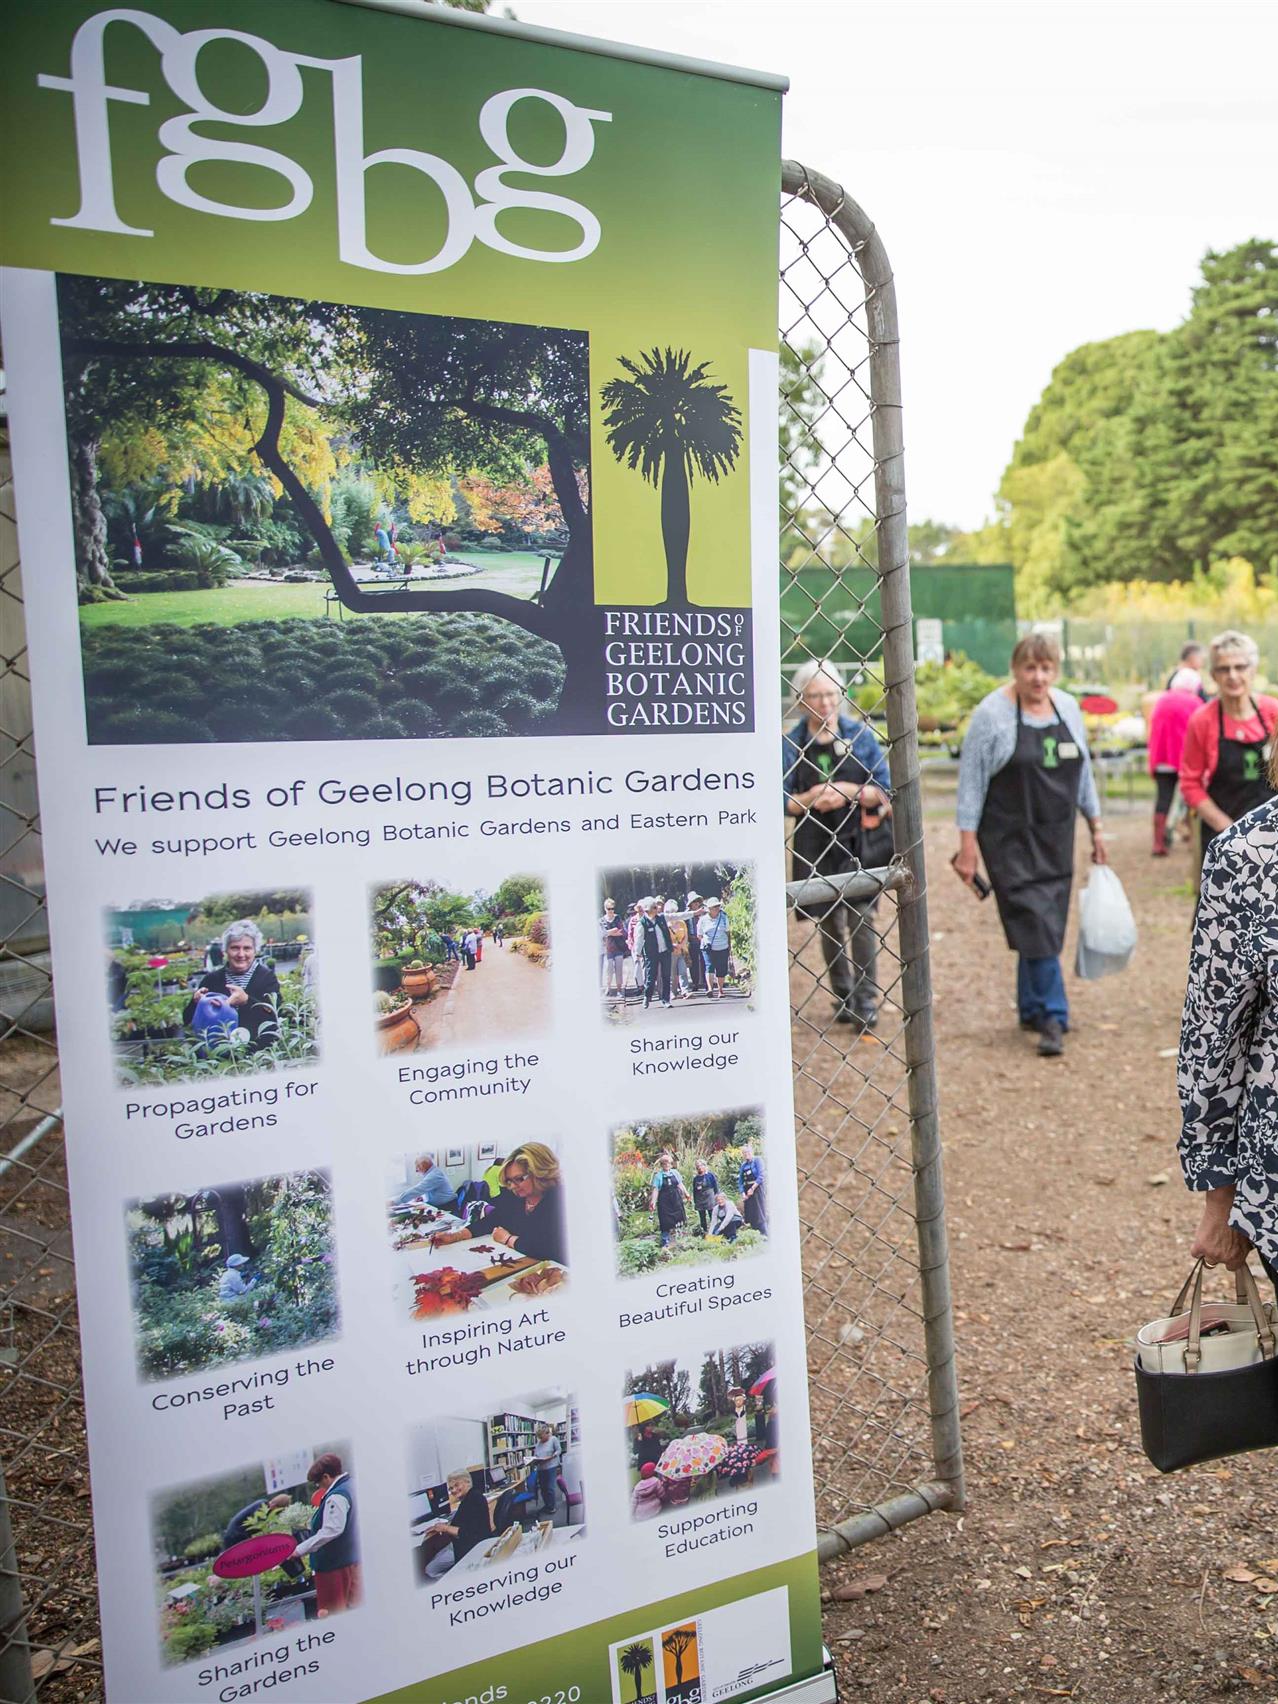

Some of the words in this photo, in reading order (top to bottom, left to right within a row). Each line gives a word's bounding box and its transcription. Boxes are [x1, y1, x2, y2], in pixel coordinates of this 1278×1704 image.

[37, 8, 613, 275] fgbg
[604, 612, 732, 637] FRIENDS
[734, 613, 744, 637] OF
[605, 641, 745, 667] GEELONG
[605, 672, 746, 697] BOTANIC
[607, 701, 746, 727] GARDENS
[94, 783, 251, 814] Friends
[266, 779, 306, 807] of
[318, 777, 472, 806] Geelong
[487, 770, 613, 798] Botanic
[625, 767, 756, 793] Gardens
[95, 838, 138, 855] We
[151, 831, 257, 857] support
[268, 827, 370, 847] Geelong
[383, 820, 470, 841] Botanic
[479, 817, 571, 837] Gardens
[581, 814, 620, 832] and
[631, 810, 708, 829] Eastern
[718, 808, 757, 825] Park
[630, 1034, 702, 1054] Sharing
[708, 1030, 740, 1046] our
[398, 1056, 499, 1084] Engaging
[503, 1053, 540, 1070] the
[632, 1051, 739, 1076] Knowledge
[125, 1086, 278, 1120] Propagating
[285, 1080, 319, 1098] for
[409, 1076, 532, 1105] Community
[175, 1111, 278, 1140] Gardens
[655, 1273, 736, 1298] Creating
[619, 1298, 703, 1328] Beautiful
[707, 1286, 773, 1312] Spaces
[422, 1317, 513, 1348] Inspiring
[517, 1309, 551, 1328] Art
[405, 1343, 491, 1376] through
[497, 1329, 567, 1355] Nature
[152, 1368, 289, 1411] Conserving
[295, 1357, 335, 1378] the
[223, 1394, 275, 1420] Past
[657, 1500, 759, 1539] Supporting
[665, 1522, 754, 1558] Education
[430, 1566, 539, 1609] Preserving
[544, 1553, 578, 1573] our
[448, 1579, 564, 1627] Knowledge
[197, 1644, 290, 1687] Sharing
[295, 1629, 336, 1653] the
[218, 1658, 321, 1703] Gardens
[712, 1678, 754, 1698] GEELONG
